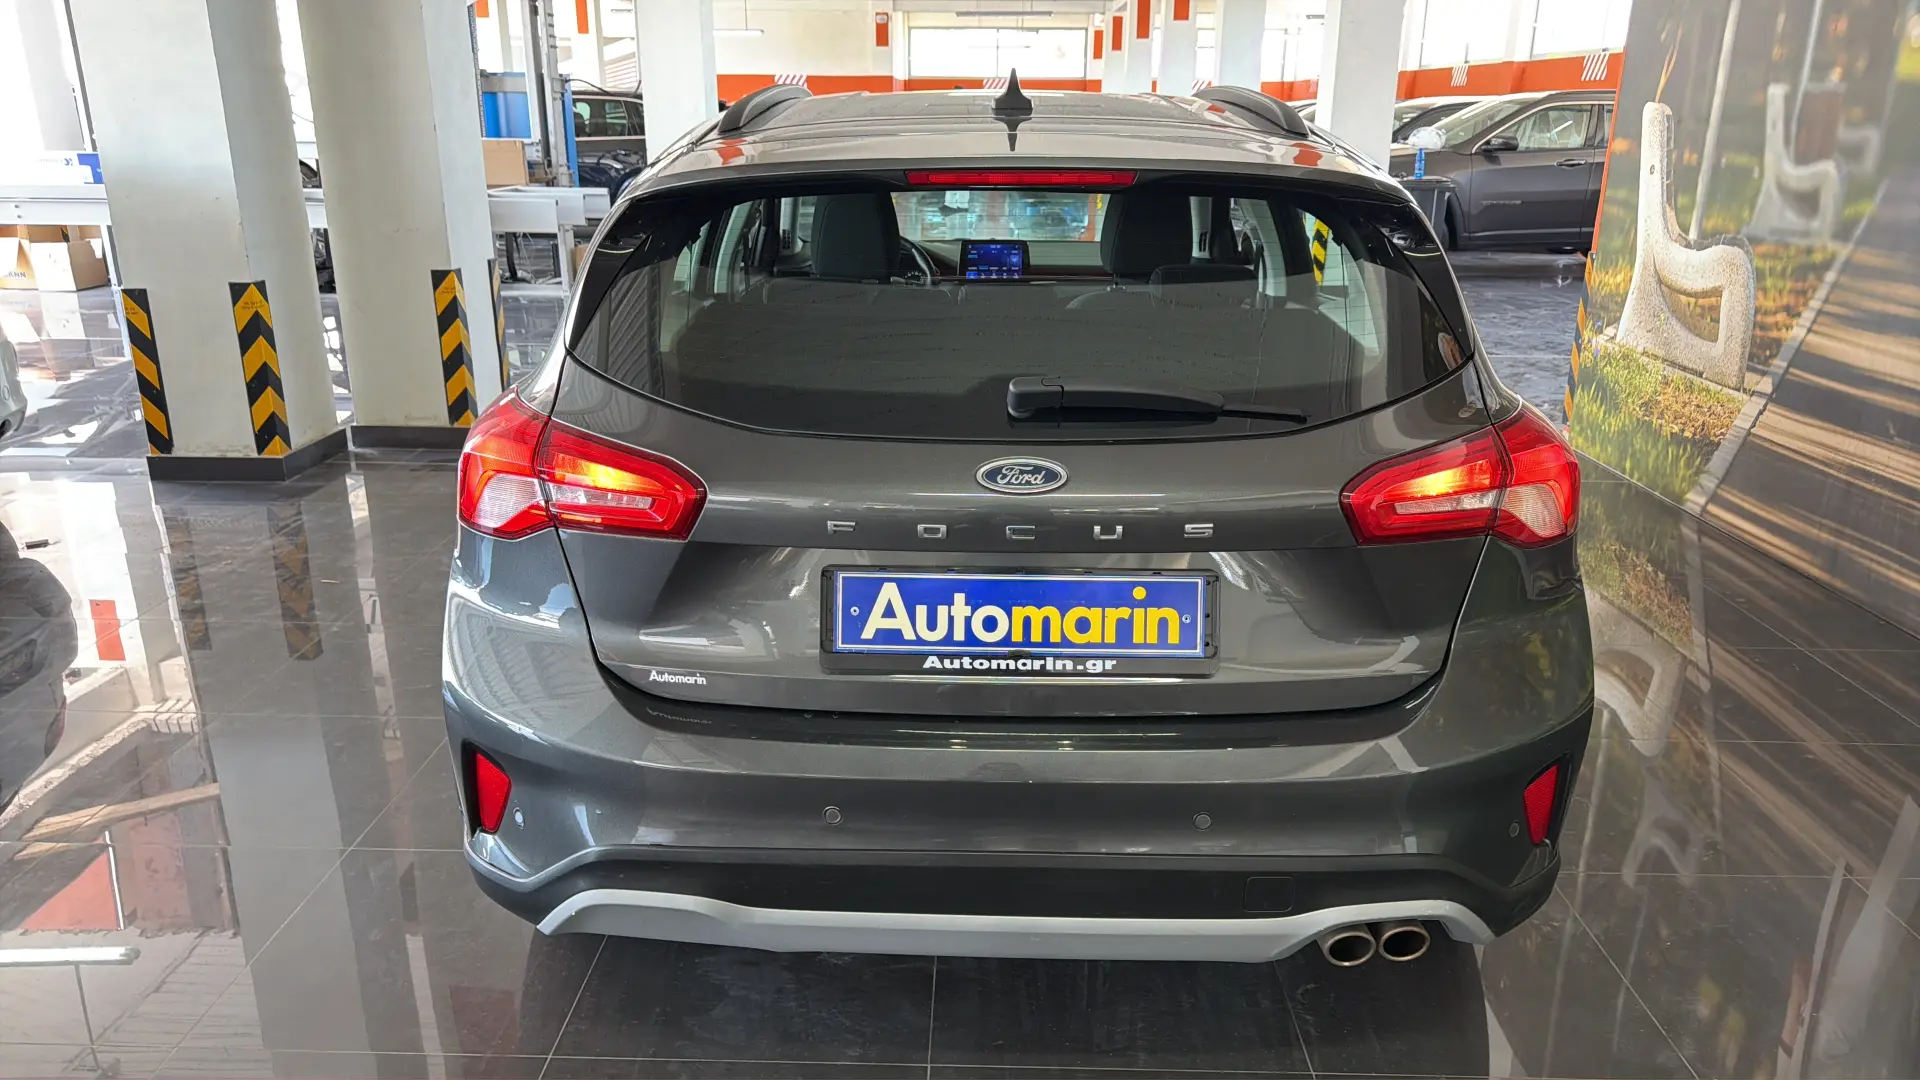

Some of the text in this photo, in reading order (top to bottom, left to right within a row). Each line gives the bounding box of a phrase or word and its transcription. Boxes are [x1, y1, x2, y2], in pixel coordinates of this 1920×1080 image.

[996, 465, 1046, 485] Ford
[827, 520, 1214, 540] FOCUS
[861, 582, 1180, 644] Automarin
[923, 655, 1117, 672] Automarin.gr
[649, 669, 707, 685] Automarin
